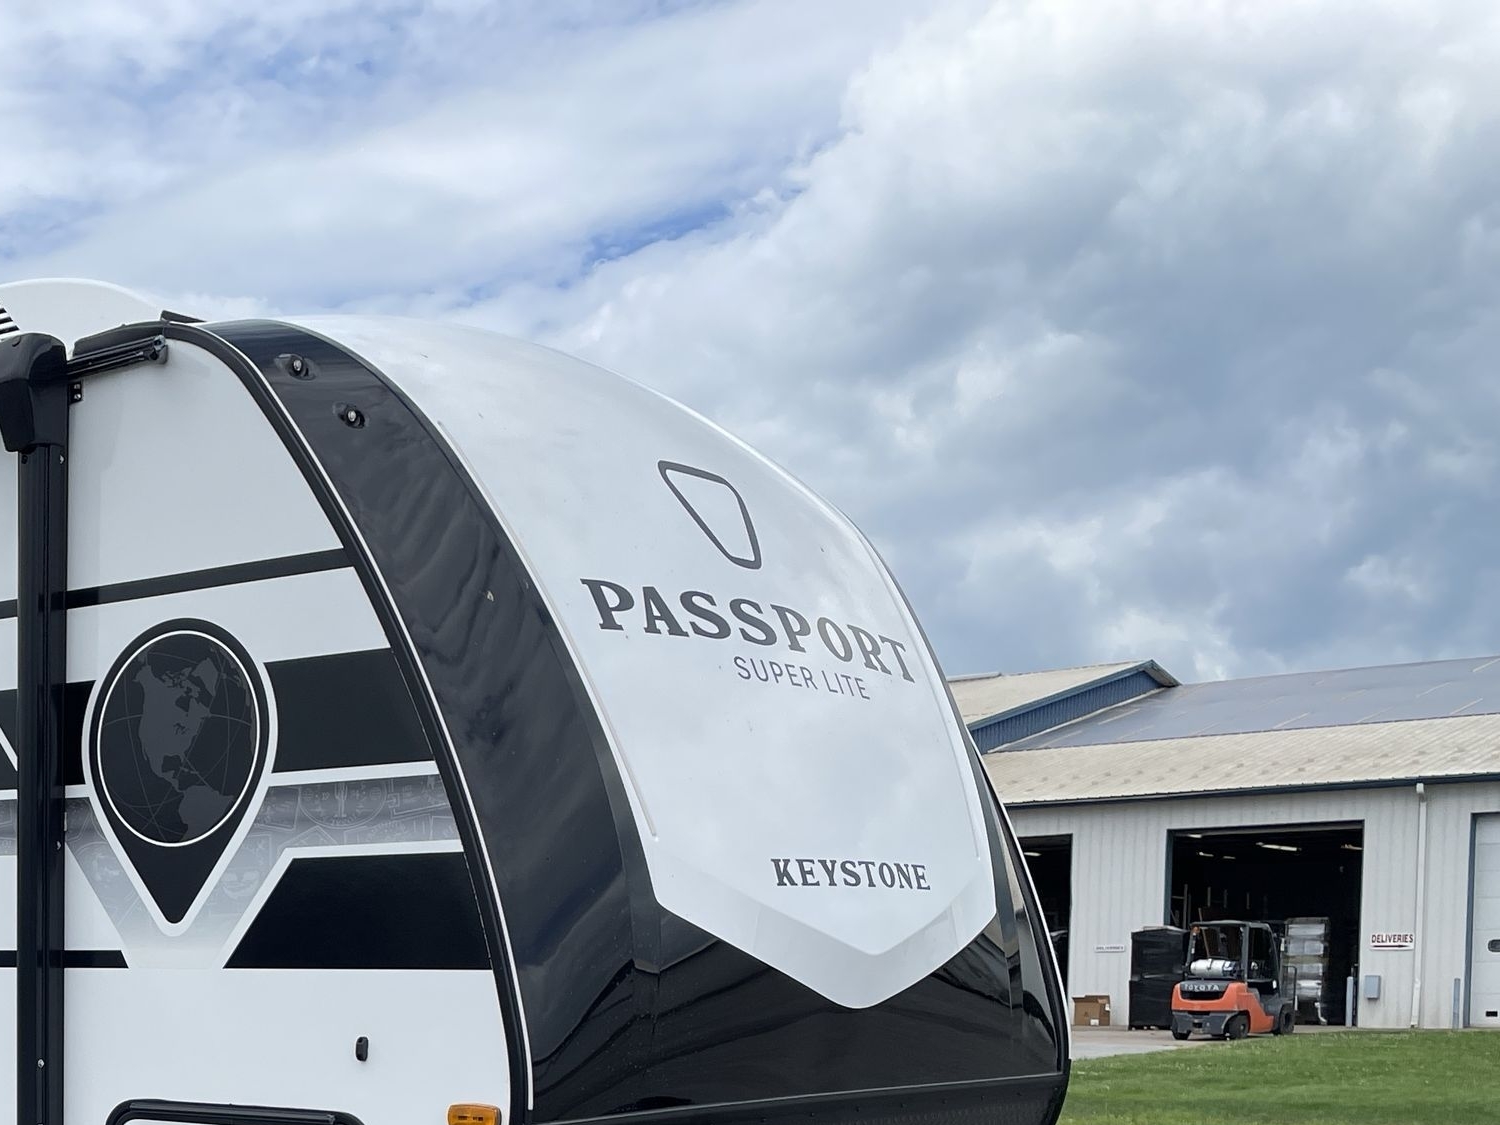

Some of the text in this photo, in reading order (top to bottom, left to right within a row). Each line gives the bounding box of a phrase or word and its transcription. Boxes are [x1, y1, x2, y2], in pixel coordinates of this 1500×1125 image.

[581, 578, 915, 683] PASSPORT
[733, 655, 871, 700] SUPER LITE
[771, 858, 931, 890] KEYSTONE
[1371, 934, 1414, 943] DELIVERIES
[1184, 983, 1220, 992] TOYOTA
